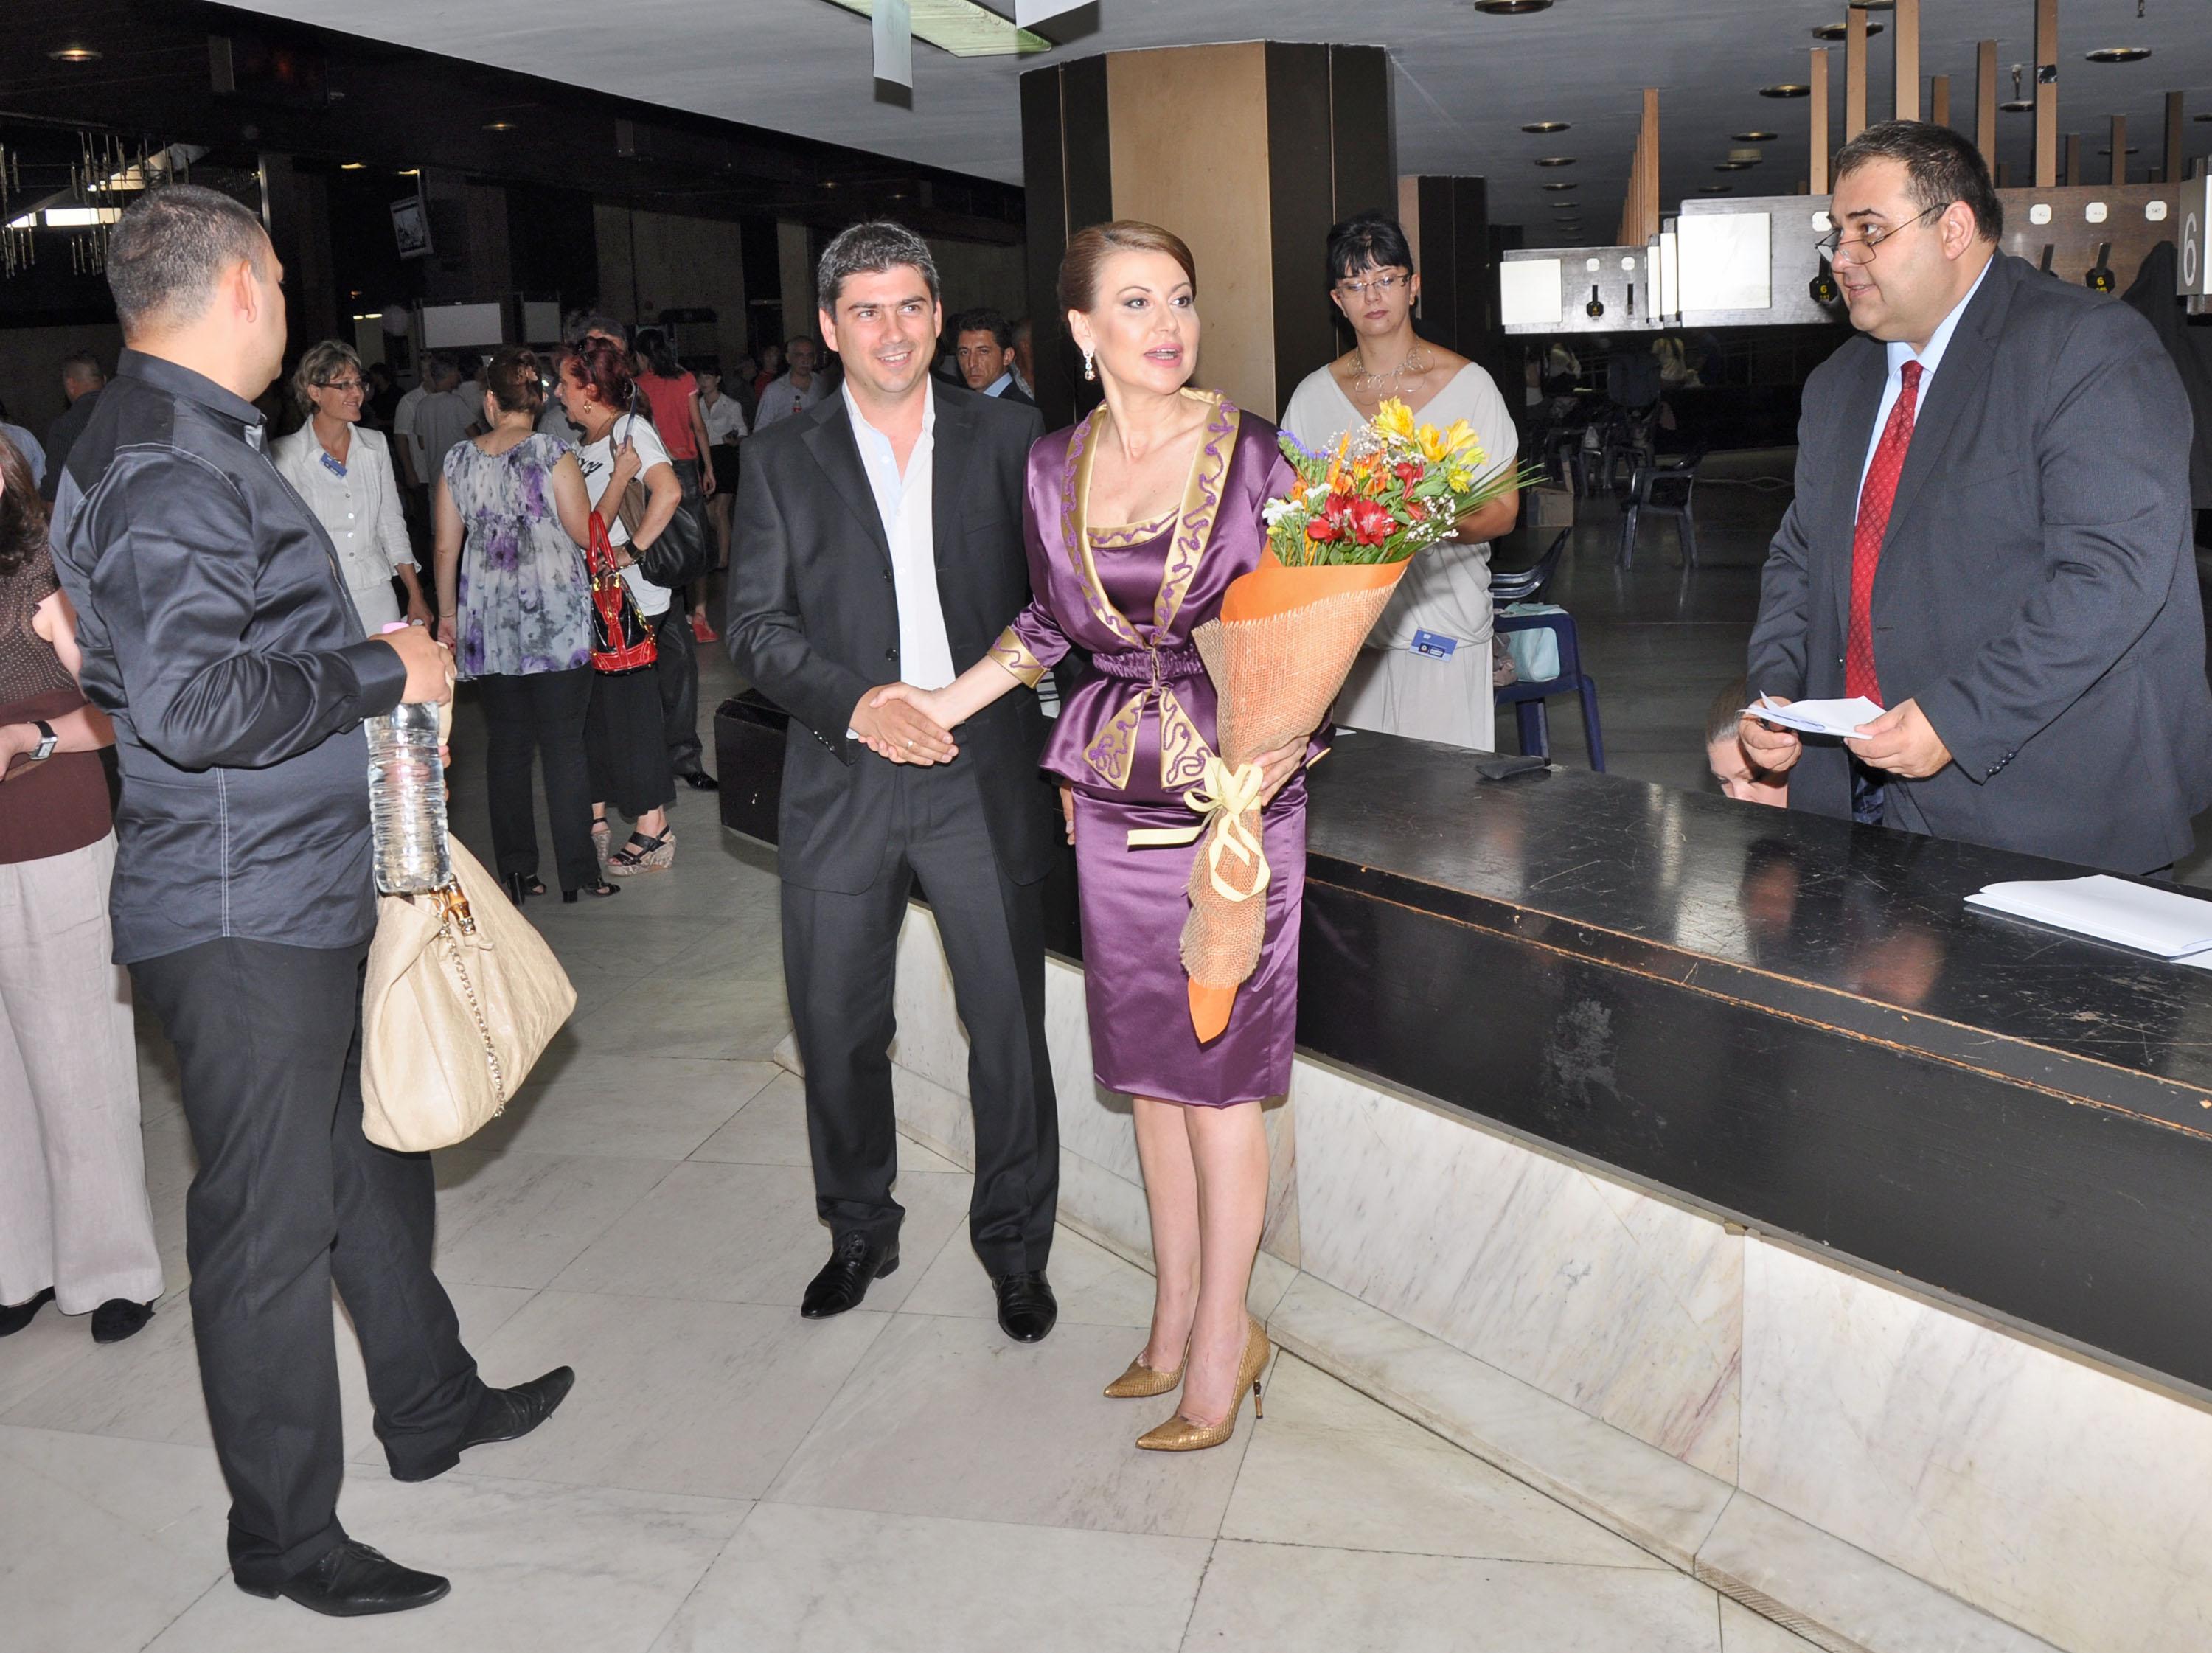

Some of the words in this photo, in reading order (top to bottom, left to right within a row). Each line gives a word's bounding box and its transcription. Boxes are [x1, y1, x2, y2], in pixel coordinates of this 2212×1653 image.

[2183, 212, 2197, 287] 6
[2096, 276, 2105, 286] 6
[1820, 285, 1828, 294] 6
